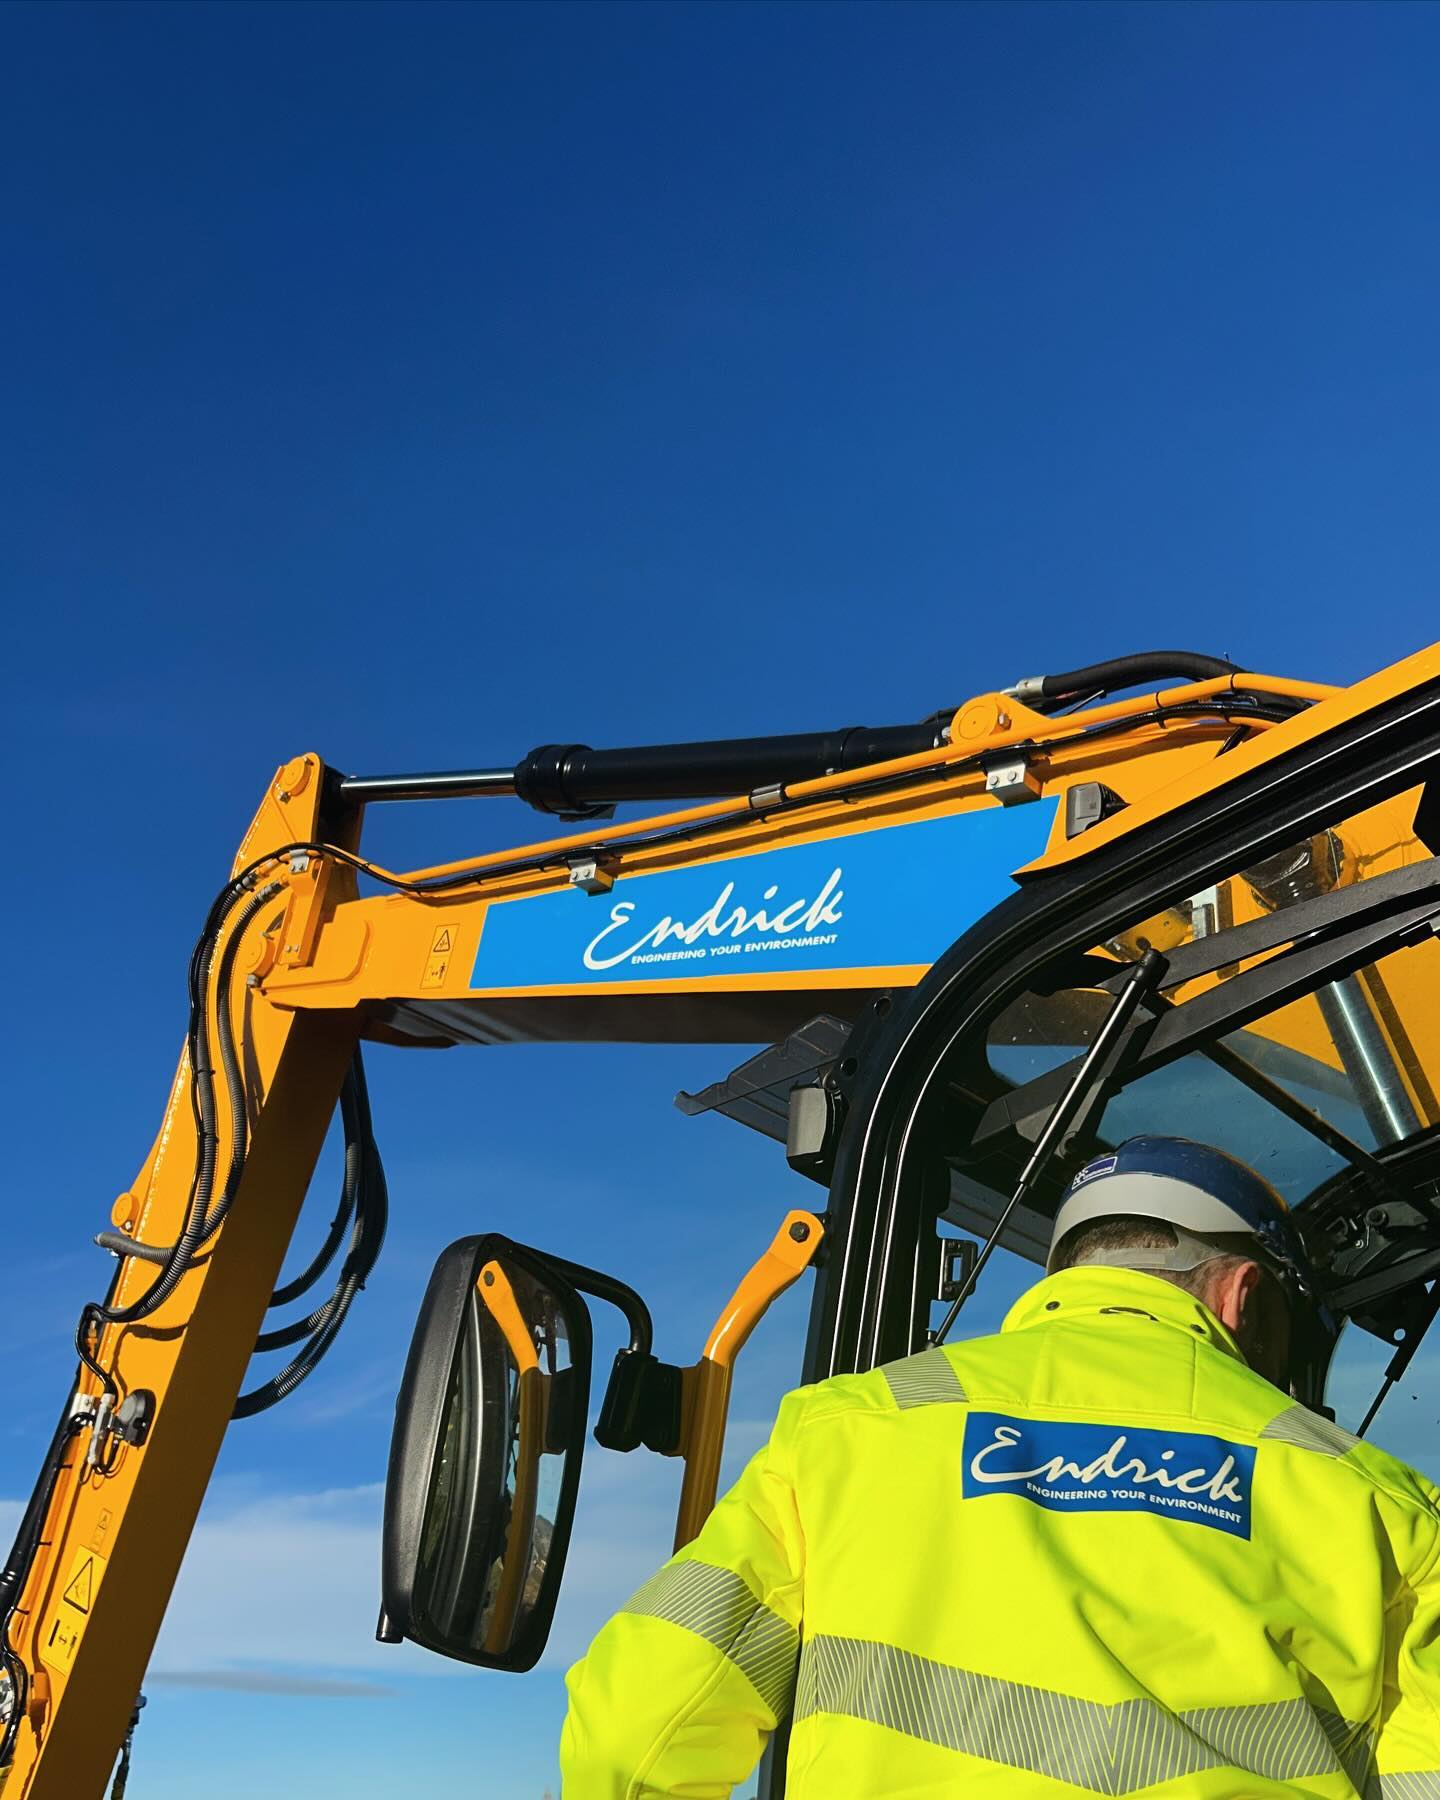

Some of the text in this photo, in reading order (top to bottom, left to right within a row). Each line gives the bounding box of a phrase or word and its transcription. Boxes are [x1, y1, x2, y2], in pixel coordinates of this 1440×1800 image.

[583, 867, 843, 971] Endrick
[631, 934, 838, 965] ENGINEERING YOUR ENVIRONMENT
[970, 1426, 1243, 1502] Endrick
[1026, 1482, 1242, 1523] ENGINEERING YOUR ENVIRONMENT
